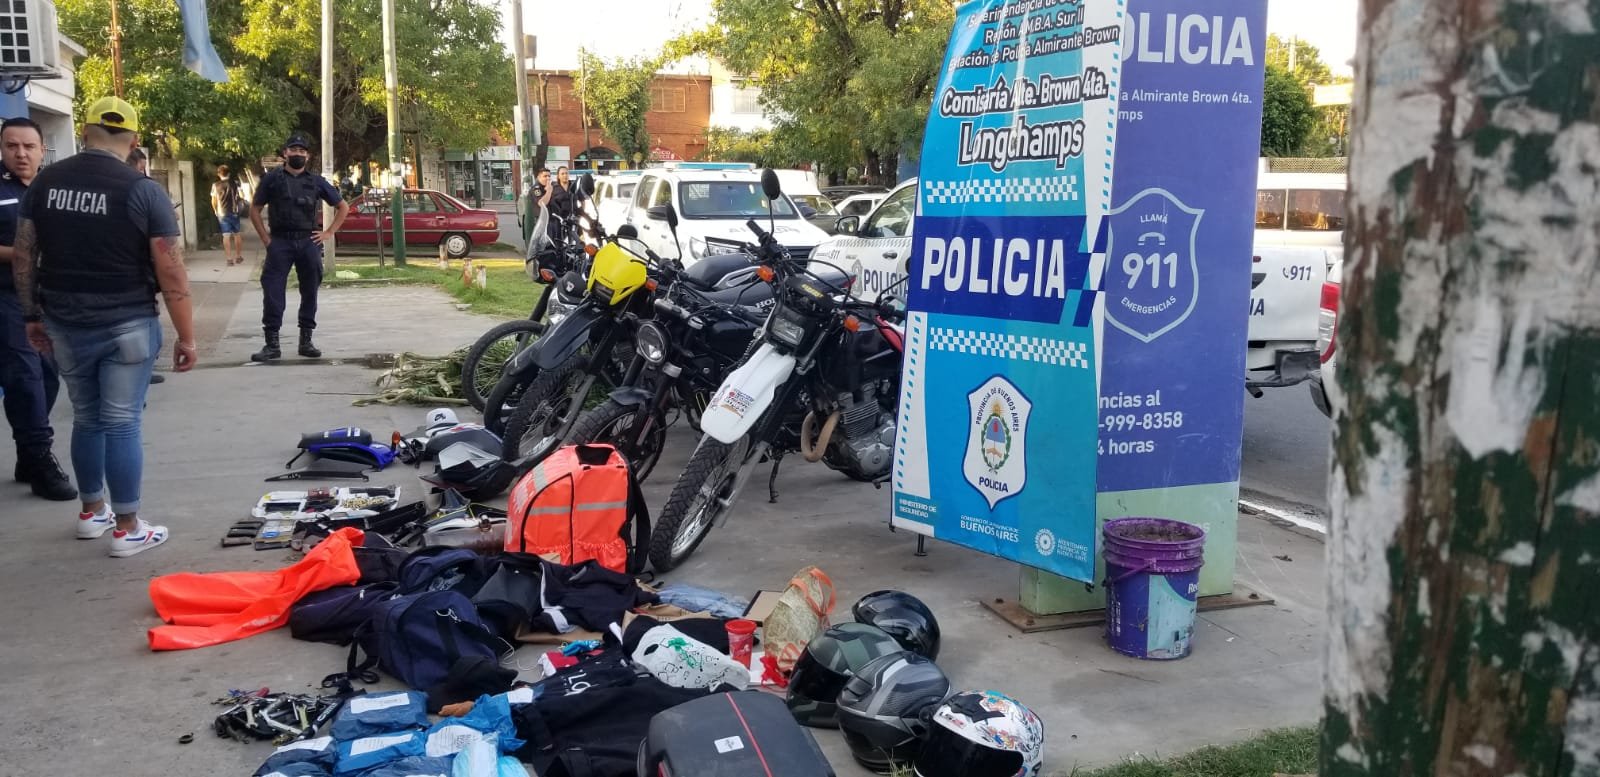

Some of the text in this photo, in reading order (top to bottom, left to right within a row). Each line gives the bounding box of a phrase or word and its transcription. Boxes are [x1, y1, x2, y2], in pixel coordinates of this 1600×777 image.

[985, 24, 1016, 44] Reión
[1056, 11, 1075, 27] Sur
[1002, 40, 1031, 61] Poliía
[1033, 34, 1082, 55] Almirante
[1085, 27, 1118, 44] Brown
[942, 70, 1107, 114] Comisaría Alte. Brown 4ta.
[1132, 88, 1189, 103] Almirante
[1192, 91, 1229, 104] Brown
[1231, 91, 1253, 104] 4ta.
[961, 119, 1083, 169] Longchamps
[47, 188, 107, 215] POLICIA
[1140, 213, 1169, 225] LLAMÁ
[921, 236, 1065, 299] POLICIA
[1122, 252, 1178, 290] 911
[1290, 265, 1312, 281] 911
[1120, 295, 1177, 315] EMERGENCIAS
[998, 387, 1016, 411] BUENOS
[1011, 412, 1019, 432] AIRES
[1099, 389, 1161, 409] ncias al
[1098, 411, 1183, 432] -999-8358
[1108, 438, 1155, 455] horas
[979, 476, 1009, 492] POLICIA
[960, 520, 995, 536] BUENOS
[996, 530, 1019, 543] AIRES
